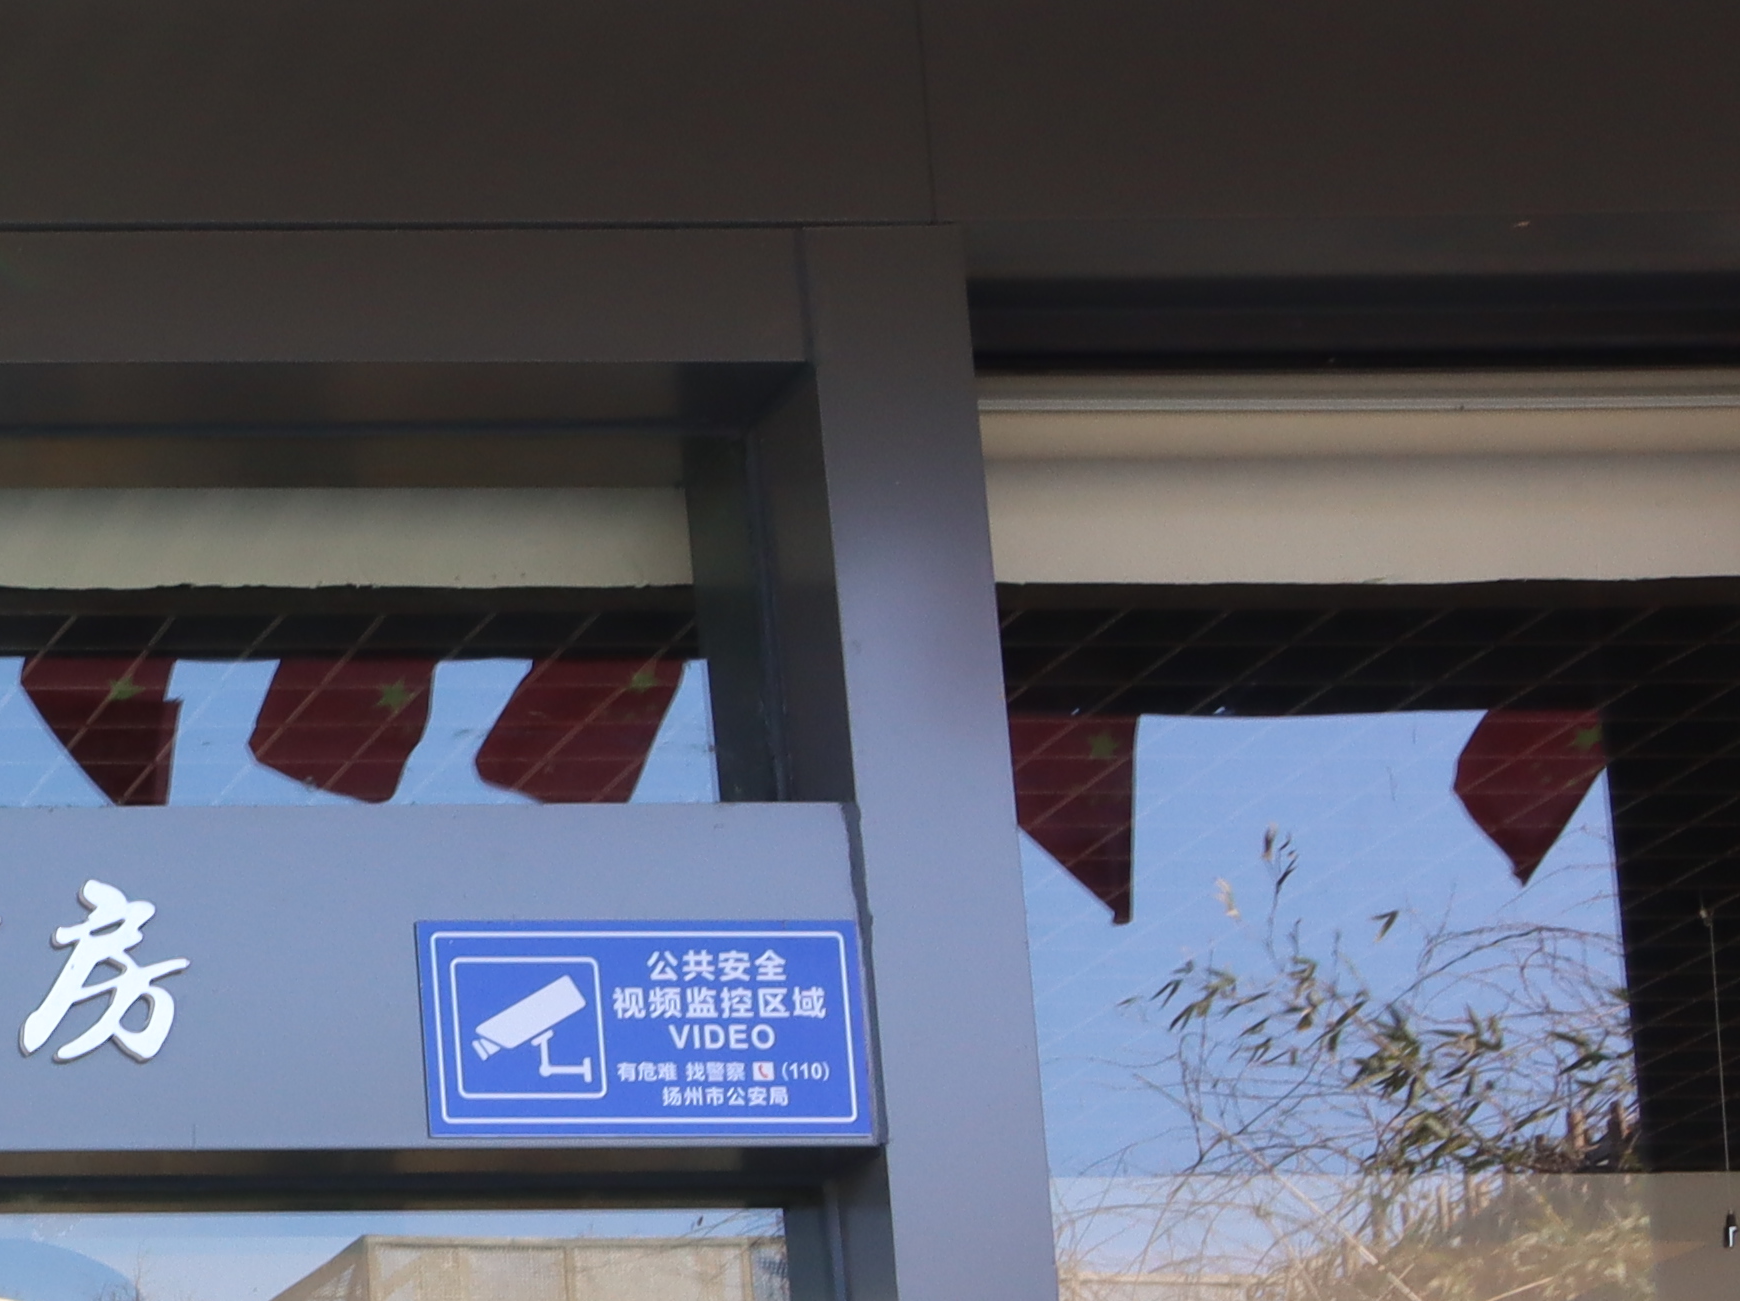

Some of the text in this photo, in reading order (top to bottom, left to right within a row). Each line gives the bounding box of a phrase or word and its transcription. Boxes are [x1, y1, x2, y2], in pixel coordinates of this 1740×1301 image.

[646, 949, 788, 982] 公共安全
[612, 986, 827, 1020] 视频监控区域
[669, 1024, 776, 1050] VIDEO
[616, 1061, 830, 1082] 有危难 找警察 (110)
[662, 1086, 789, 1107] 扬州市公安局
